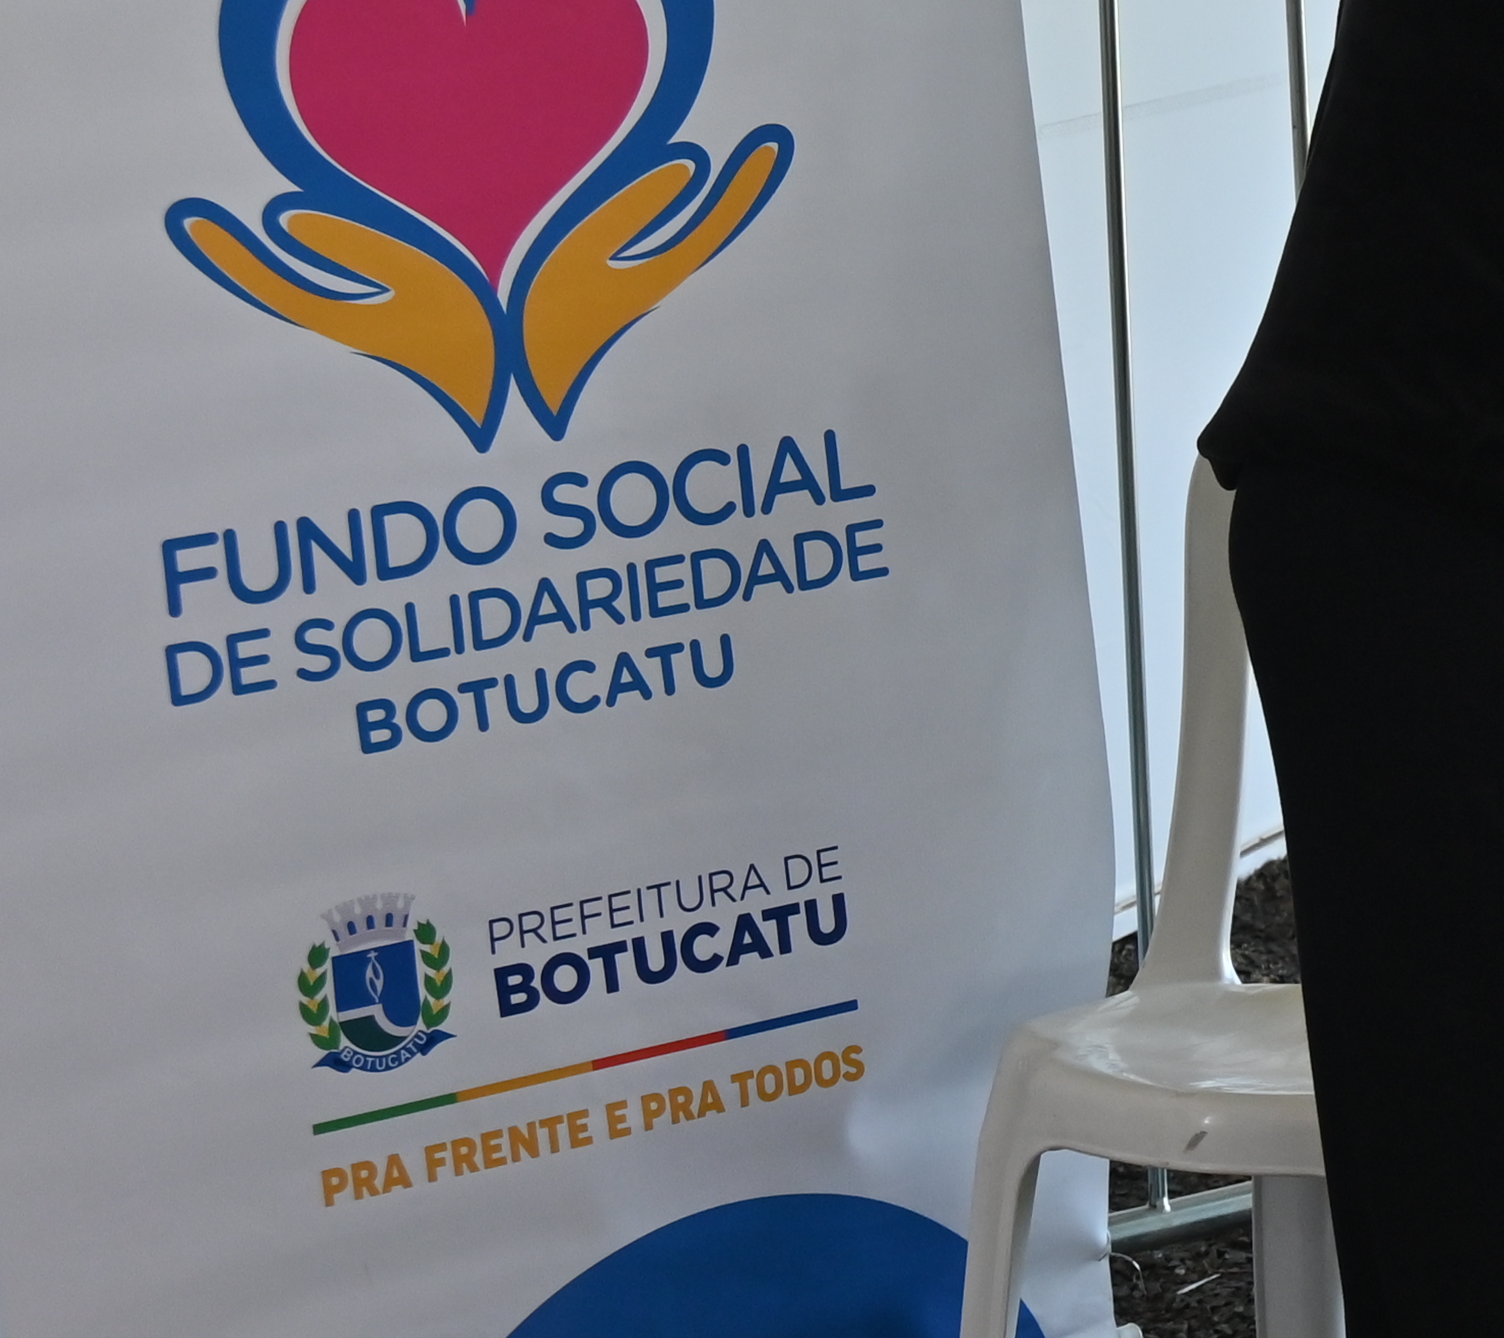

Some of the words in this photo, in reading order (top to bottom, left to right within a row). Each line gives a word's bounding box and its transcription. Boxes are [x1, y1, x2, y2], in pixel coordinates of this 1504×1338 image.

[162, 486, 518, 618] FUNDO
[540, 428, 877, 551] SOCIAL
[164, 626, 279, 708] DE
[293, 518, 890, 683] SOLIDARIEDADE
[355, 633, 736, 755] BOTUCATU
[487, 862, 772, 956] PREFEITURA
[783, 845, 845, 891] DE
[493, 891, 849, 1019] BOTUCATU
[339, 1030, 428, 1072] BOTUCATU
[320, 1152, 413, 1208] PRA
[423, 1107, 595, 1184] FRENTE
[605, 1099, 632, 1141] E
[639, 1079, 726, 1132] PRA
[729, 1044, 866, 1109] TODOS
